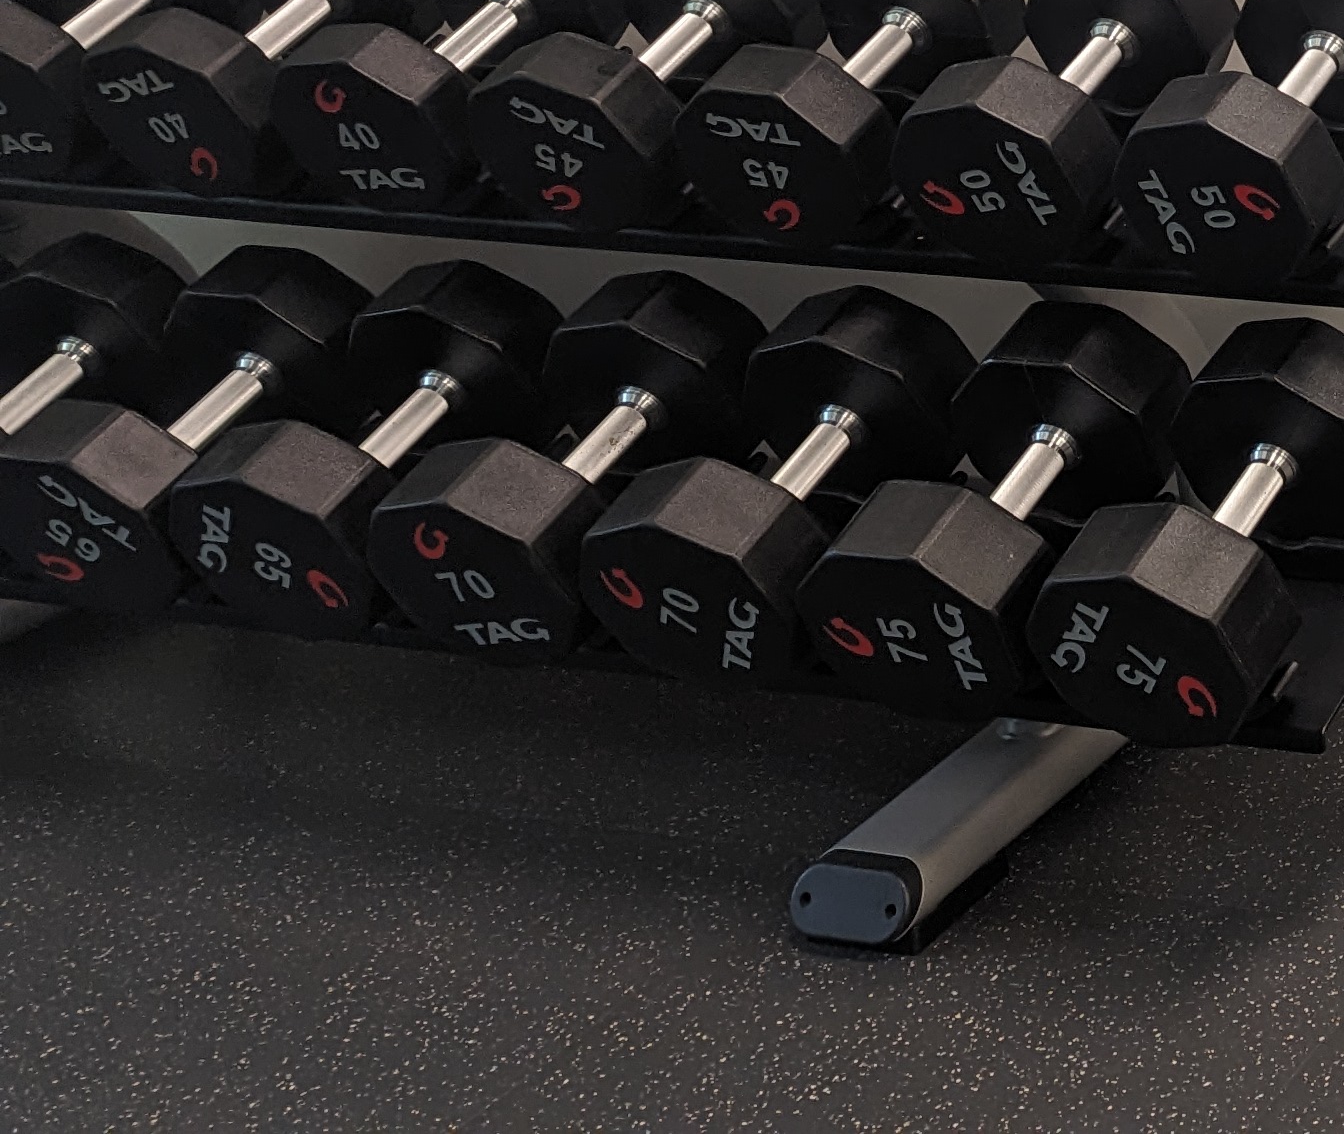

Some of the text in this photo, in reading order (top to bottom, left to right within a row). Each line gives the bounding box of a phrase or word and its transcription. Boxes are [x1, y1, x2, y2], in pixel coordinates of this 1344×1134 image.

[98, 70, 174, 102] TAG
[0, 132, 53, 154] AG
[149, 113, 189, 142] 40
[339, 123, 379, 149] 40
[510, 97, 604, 148] TAG
[706, 113, 800, 146] TAG
[340, 168, 425, 189] TAG
[535, 144, 582, 177] 45
[743, 159, 788, 189] 45
[960, 170, 1005, 212] 50
[996, 142, 1056, 225] TAG
[1138, 170, 1195, 254] TAG
[1191, 186, 1235, 228] 50
[40, 476, 136, 550] TAG
[46, 520, 100, 561] 65
[198, 505, 230, 572] TAG
[255, 543, 291, 588] 65
[435, 570, 495, 601] 70
[454, 618, 549, 645] TAG
[660, 588, 699, 633] 70
[723, 598, 759, 669] TAG
[876, 618, 928, 662] 75
[934, 603, 987, 690] TAG
[1051, 603, 1109, 672] TAG
[1117, 645, 1166, 693] 75
